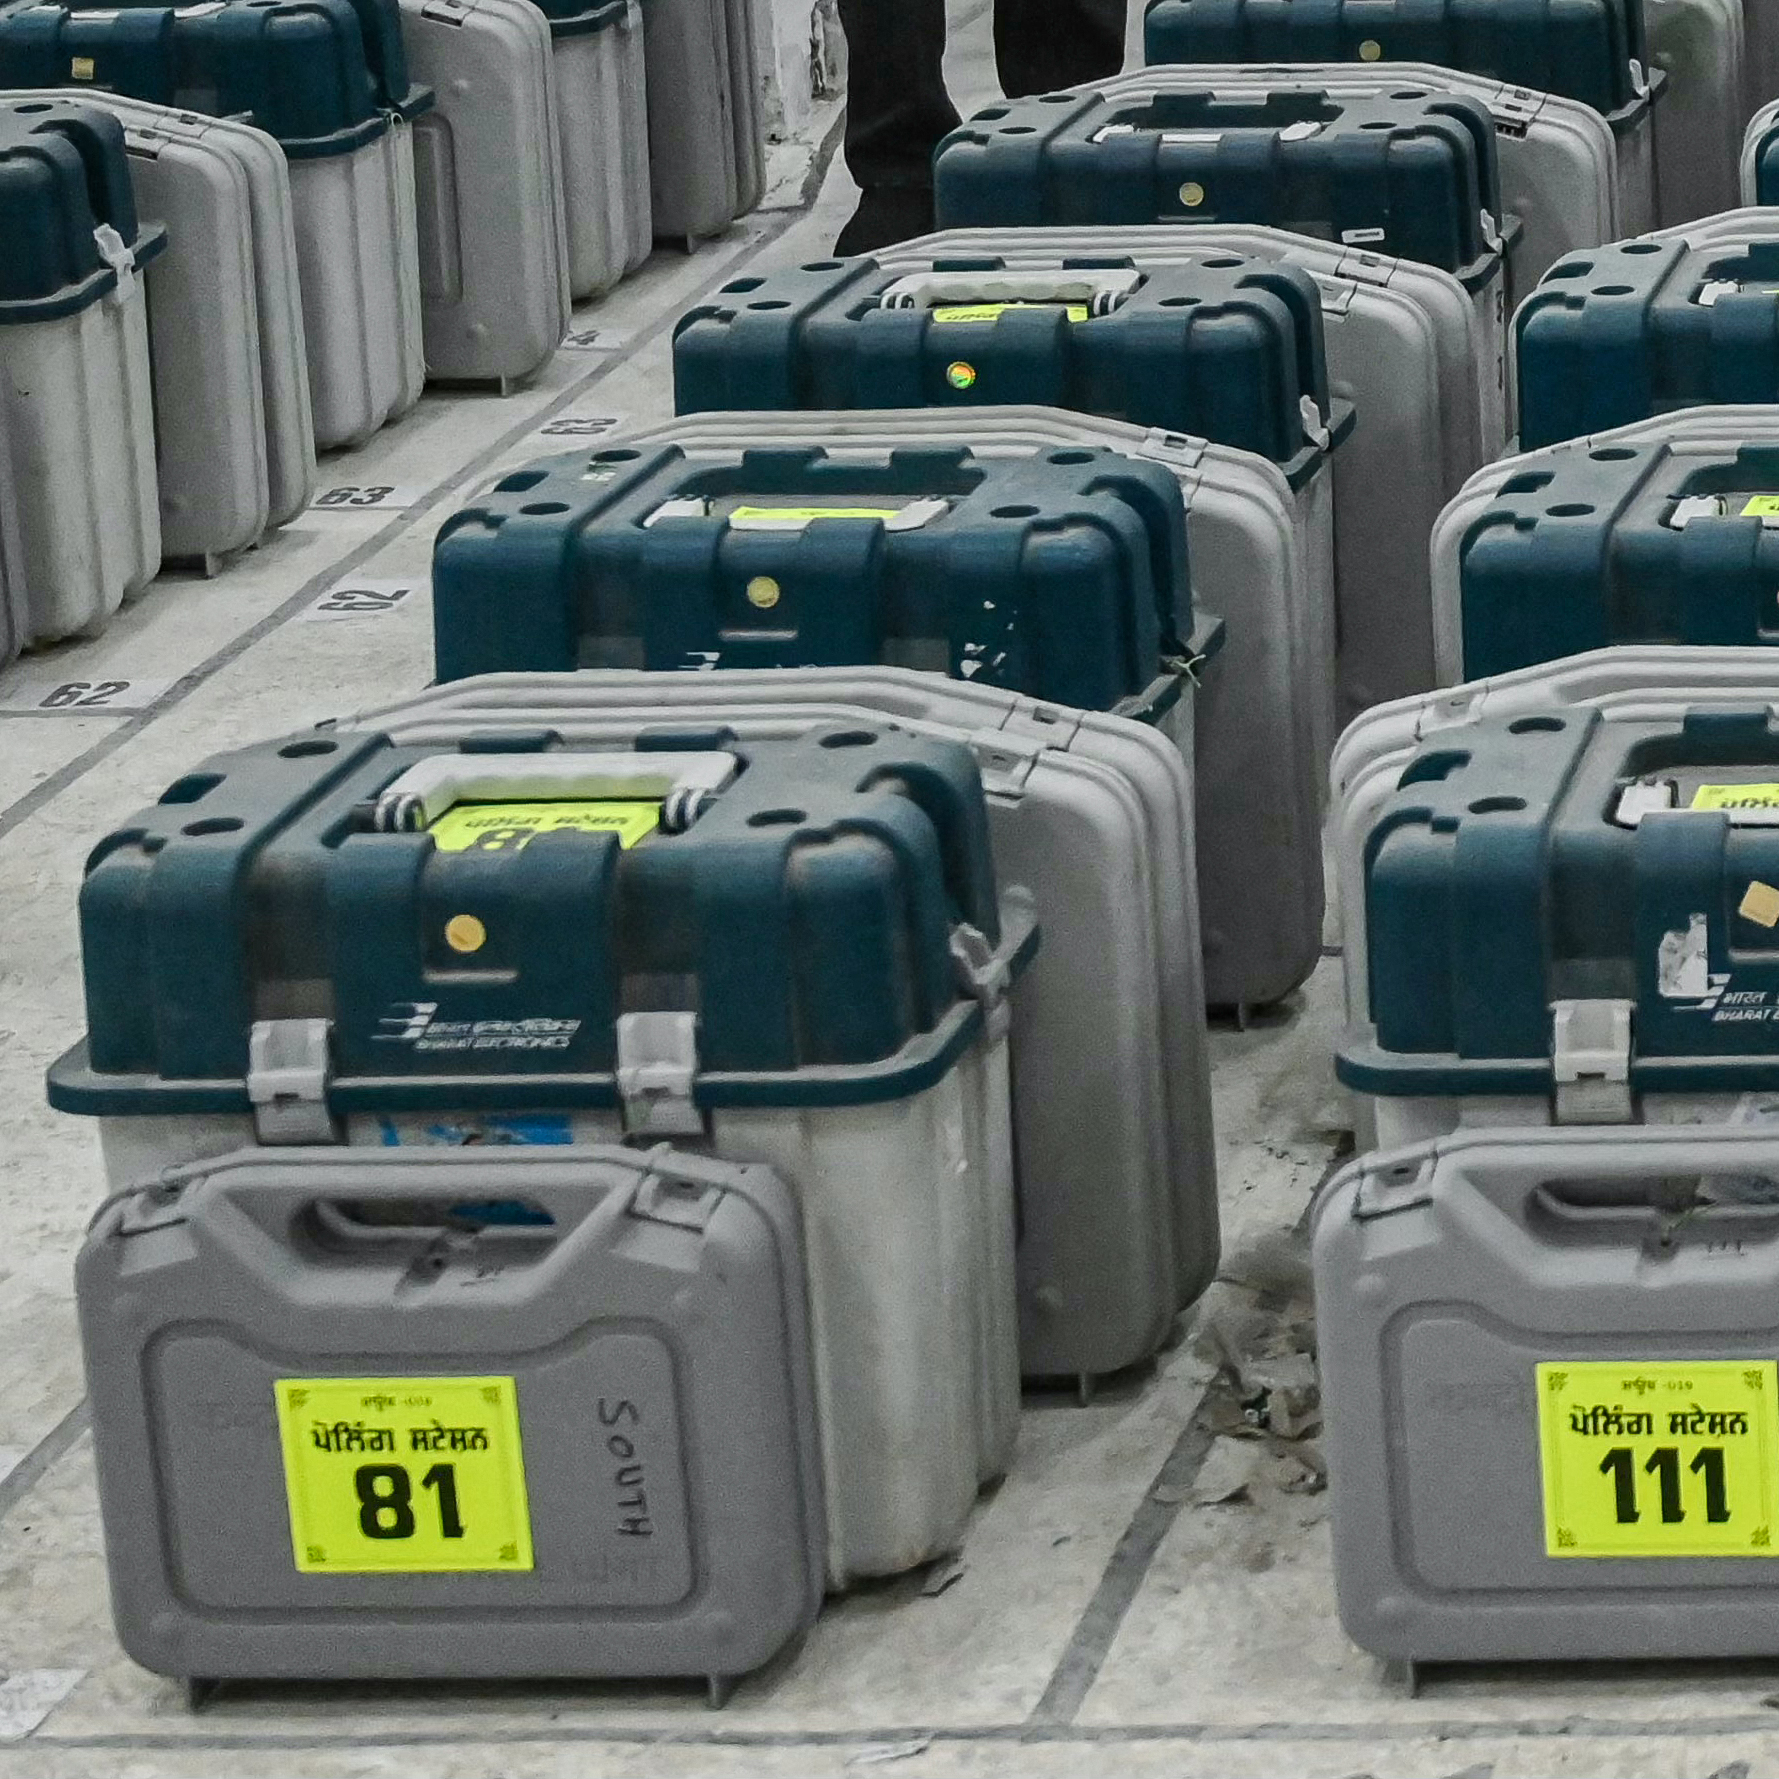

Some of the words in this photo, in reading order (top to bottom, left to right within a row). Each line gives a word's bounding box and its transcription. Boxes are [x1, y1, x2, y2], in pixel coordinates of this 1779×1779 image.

[318, 589, 411, 611] 62
[39, 682, 130, 707] 62
[1713, 1008, 1770, 1021] BHARAT
[311, 1421, 394, 1453] ਪੋਲਿੰਗ
[1569, 1404, 1653, 1435] ਪੋਲਿੰਗ
[1667, 1402, 1749, 1438] ਸਟੇਸ਼ਨ
[598, 1396, 654, 1538] SOUTH
[355, 1463, 468, 1539] 81
[1600, 1447, 1731, 1523] 111
